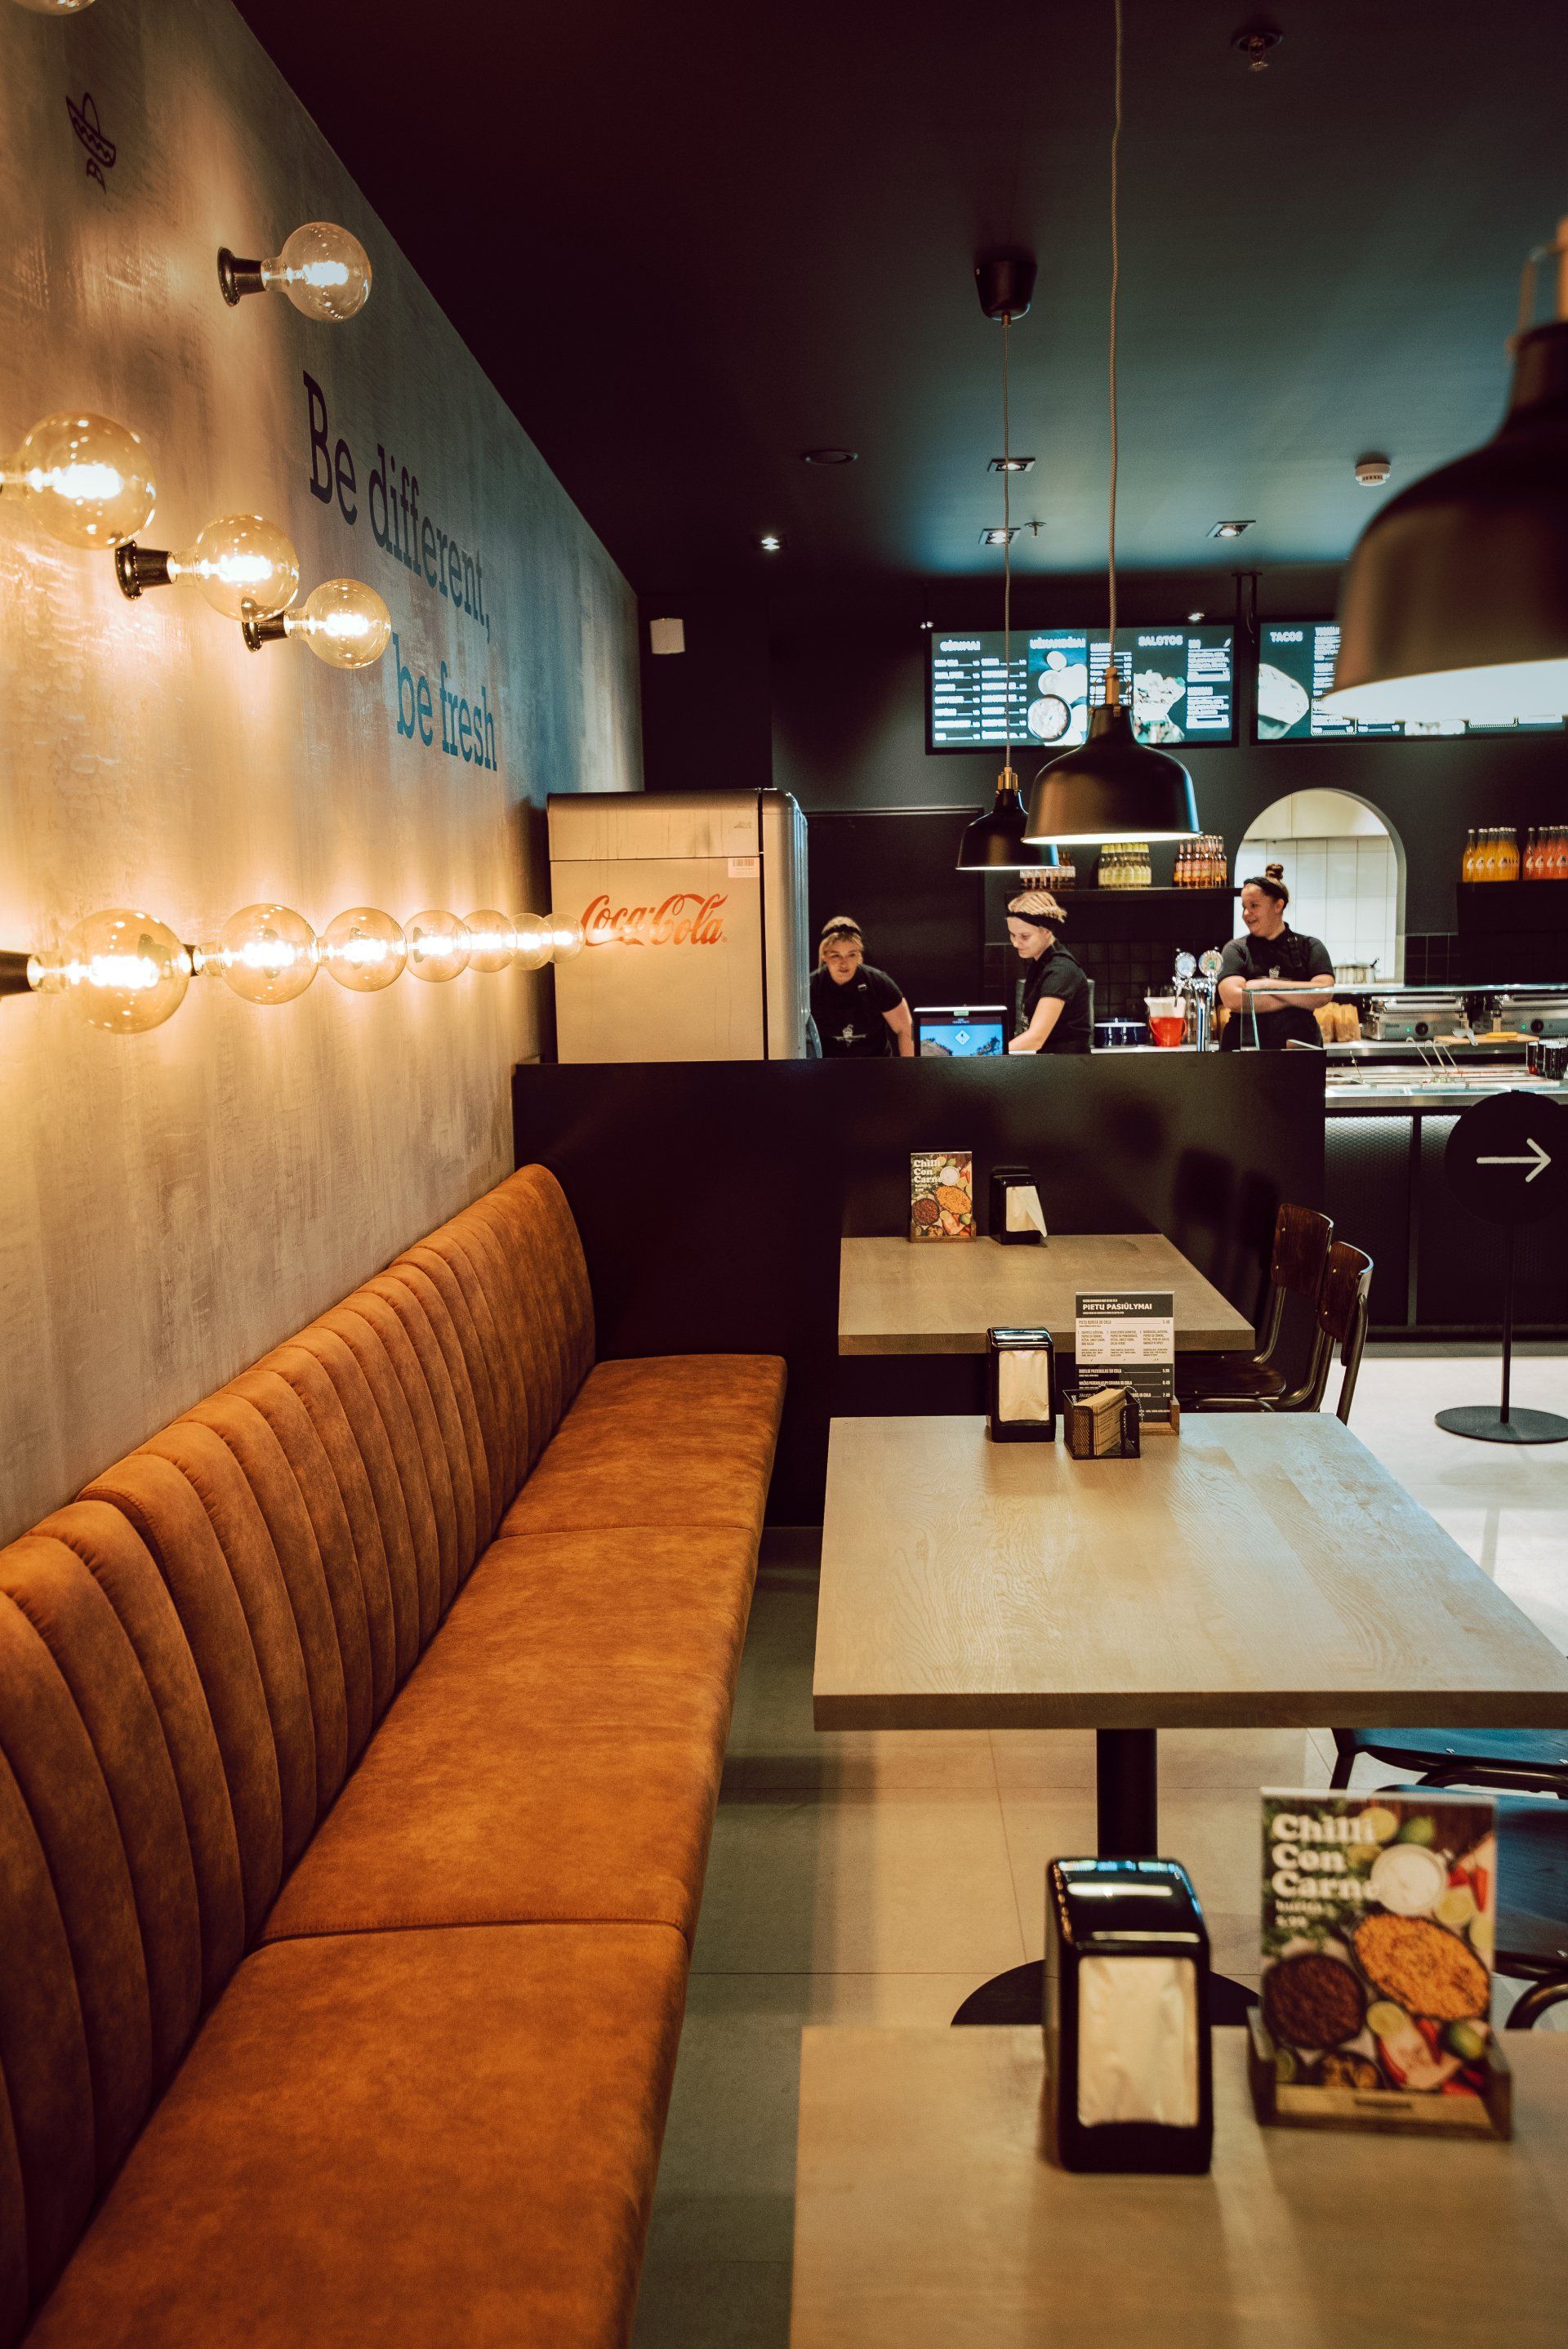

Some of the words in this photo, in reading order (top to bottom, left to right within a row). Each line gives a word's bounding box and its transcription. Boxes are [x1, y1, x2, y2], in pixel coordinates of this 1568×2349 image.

[303, 370, 358, 525] Be
[369, 443, 490, 642] different,
[1138, 635, 1183, 647] SALOTOS
[1270, 631, 1303, 643] TACOS
[393, 633, 434, 747] be
[439, 660, 497, 772] fresh
[580, 894, 729, 947] Coca-Cola
[913, 1159, 942, 1168] Chilli
[913, 1168, 934, 1176] Con
[1107, 1302, 1152, 1310] PASIŪLYMAI
[1272, 1813, 1376, 1845] Chilli
[1272, 1843, 1347, 1872] Con
[1272, 1870, 1381, 1901] Carne
